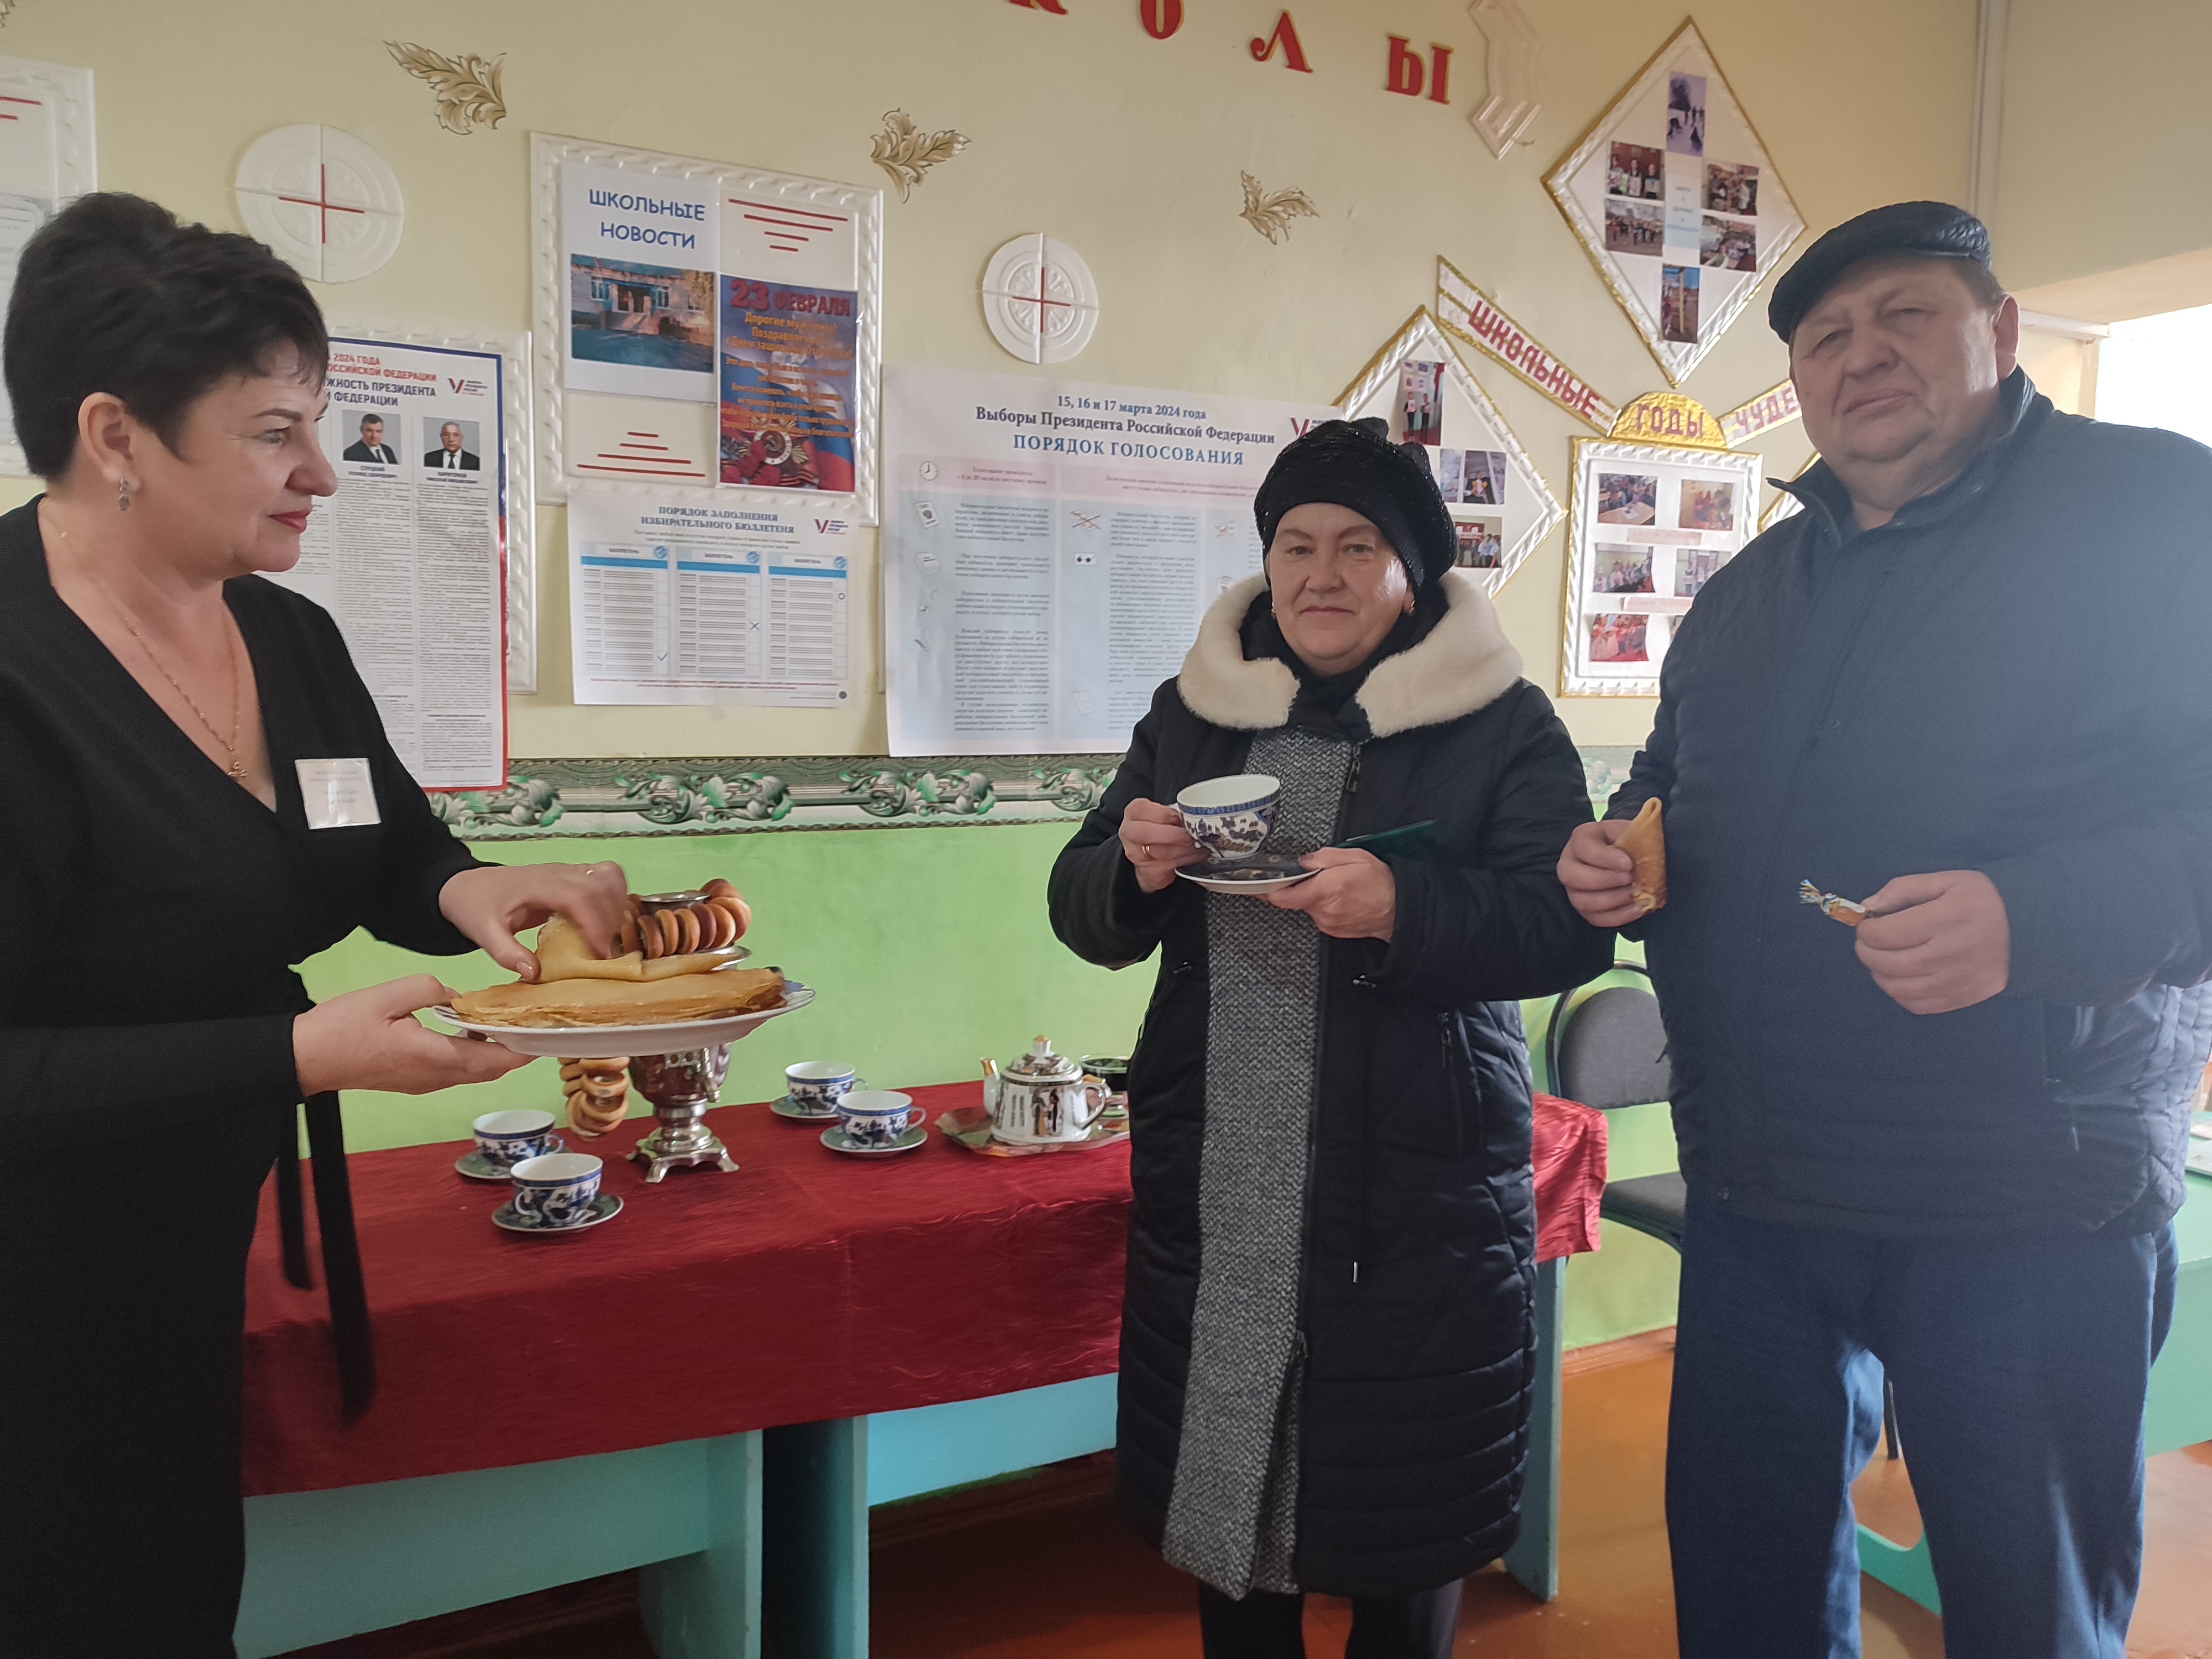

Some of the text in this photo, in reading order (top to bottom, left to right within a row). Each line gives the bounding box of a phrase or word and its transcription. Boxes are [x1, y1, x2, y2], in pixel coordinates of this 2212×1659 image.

[1009, 0, 1454, 104] ОЛЫ
[589, 189, 706, 221] ШКОЛЬНЫЕ
[601, 221, 695, 249] НОВОСТИ
[731, 279, 851, 317] 23 ФЕВРАЛЯ
[745, 312, 785, 326] Дорогие
[327, 363, 437, 382] ОССИЙСКОЙ ФЕДЕРАЦИИ
[333, 353, 355, 362] 2024
[357, 356, 380, 365] ГОДА
[1468, 300, 1603, 420] ШКОЛЬНЫЕ
[325, 377, 437, 397] ЖНОСТЬ ПРЕЗИДЕНТА
[333, 391, 399, 406] ФЕДЕРАЦИИ
[1057, 395, 1206, 419] 15, 16 и 17 марта 2024 года
[1636, 404, 1704, 437] ГОДЫ
[1735, 387, 1798, 435] ЧУДЕ
[975, 406, 1275, 445] Выборы Президента Российской Федерации
[1013, 434, 1244, 466] ПОРЯДОК ГОЛОСОВАНИЯ
[641, 516, 795, 534] ИЗБИРАТЕЛЬНОГО БЮЛЛЕТЕНЯ
[659, 506, 779, 522] ПОРЯДОК ЗАПОЛНЕНИЯ
